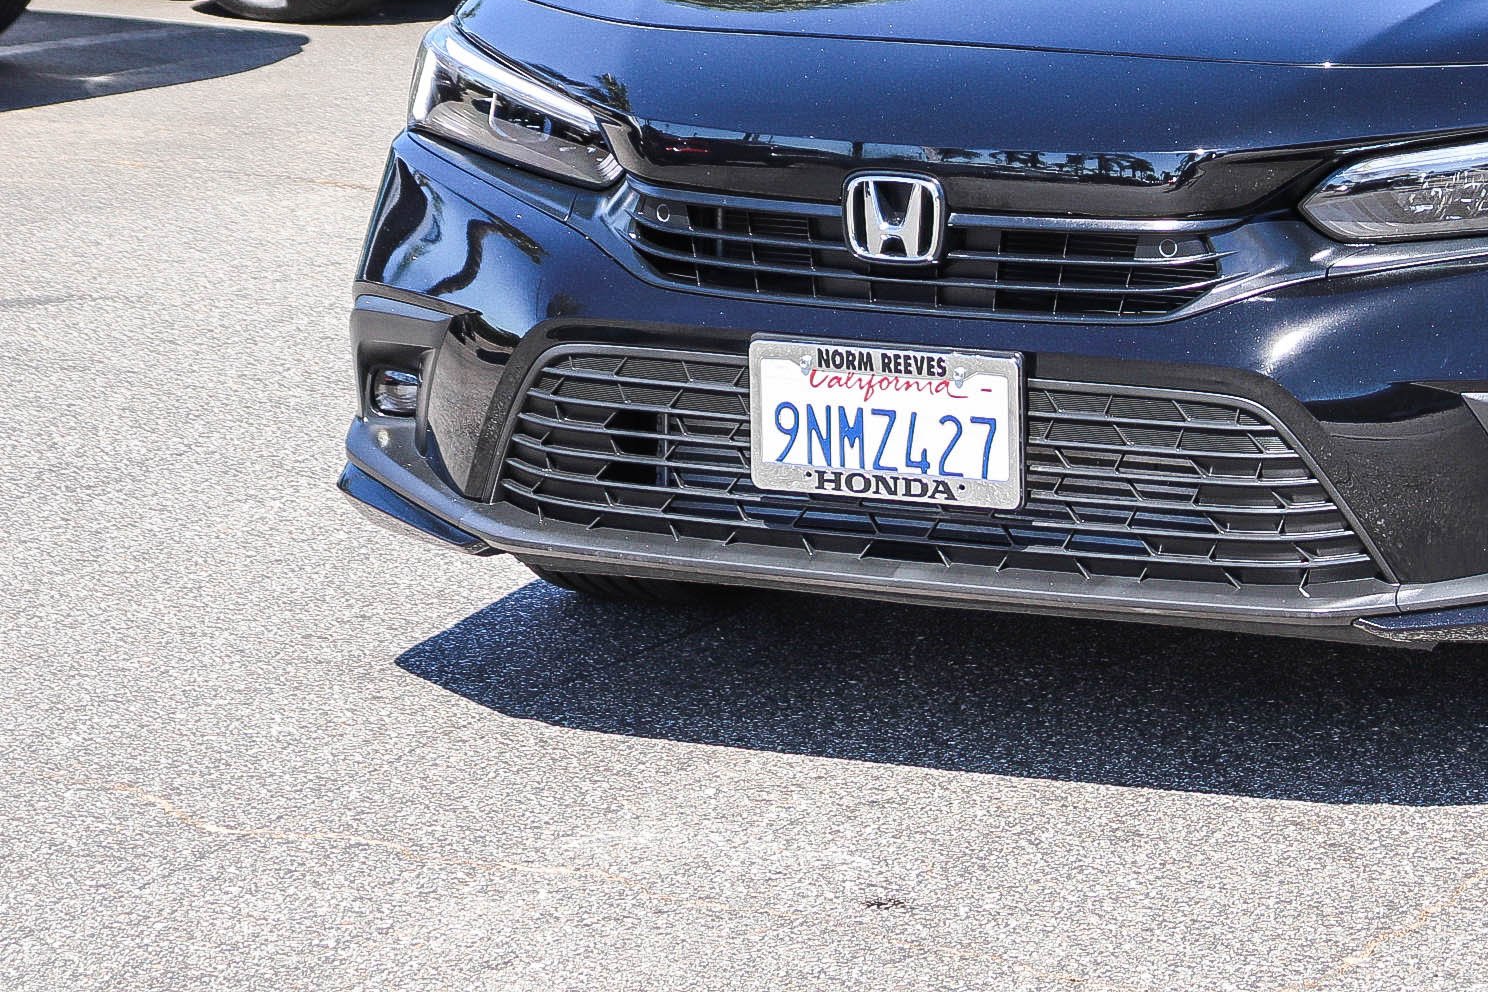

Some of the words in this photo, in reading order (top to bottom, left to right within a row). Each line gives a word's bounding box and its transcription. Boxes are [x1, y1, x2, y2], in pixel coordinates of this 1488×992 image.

[816, 347, 874, 372] NORM
[881, 352, 947, 378] REEVES
[809, 368, 968, 402] California
[774, 401, 997, 480] 9NMZ427
[814, 469, 958, 501] HONDA
